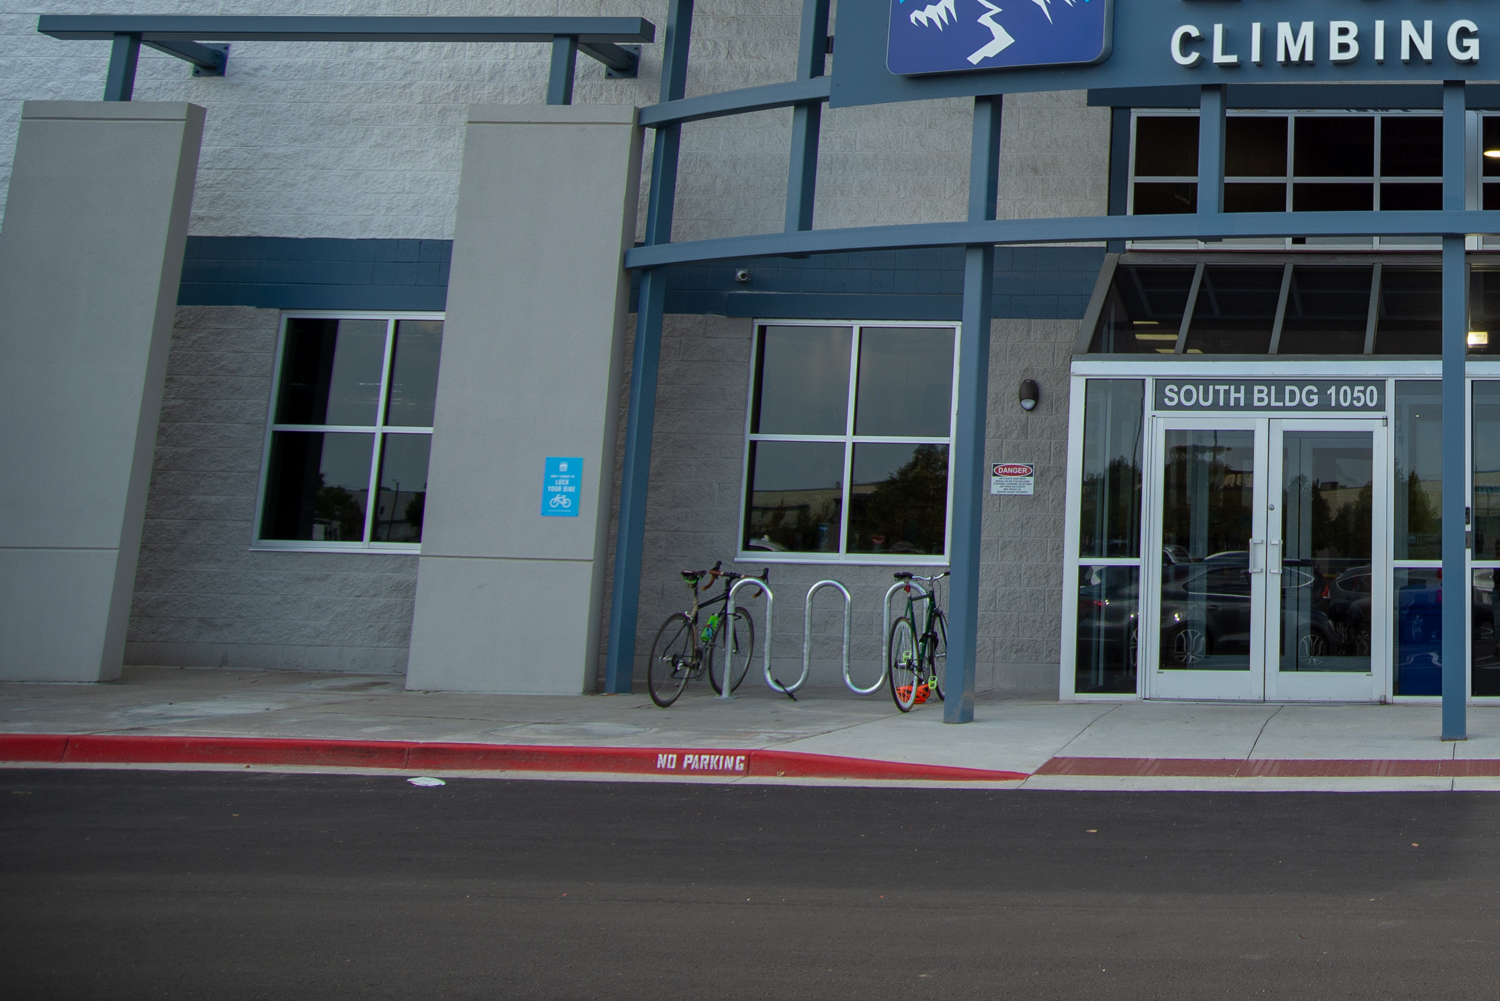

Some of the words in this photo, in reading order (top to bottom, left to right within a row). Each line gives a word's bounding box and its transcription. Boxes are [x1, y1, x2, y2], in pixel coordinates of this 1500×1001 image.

[1170, 19, 1480, 67] CLIMBING
[1163, 384, 1245, 407] SOUTH
[1253, 385, 1319, 407] BLDG
[1326, 385, 1378, 407] 1050
[656, 753, 677, 769] NO
[682, 754, 746, 771] PARKING
